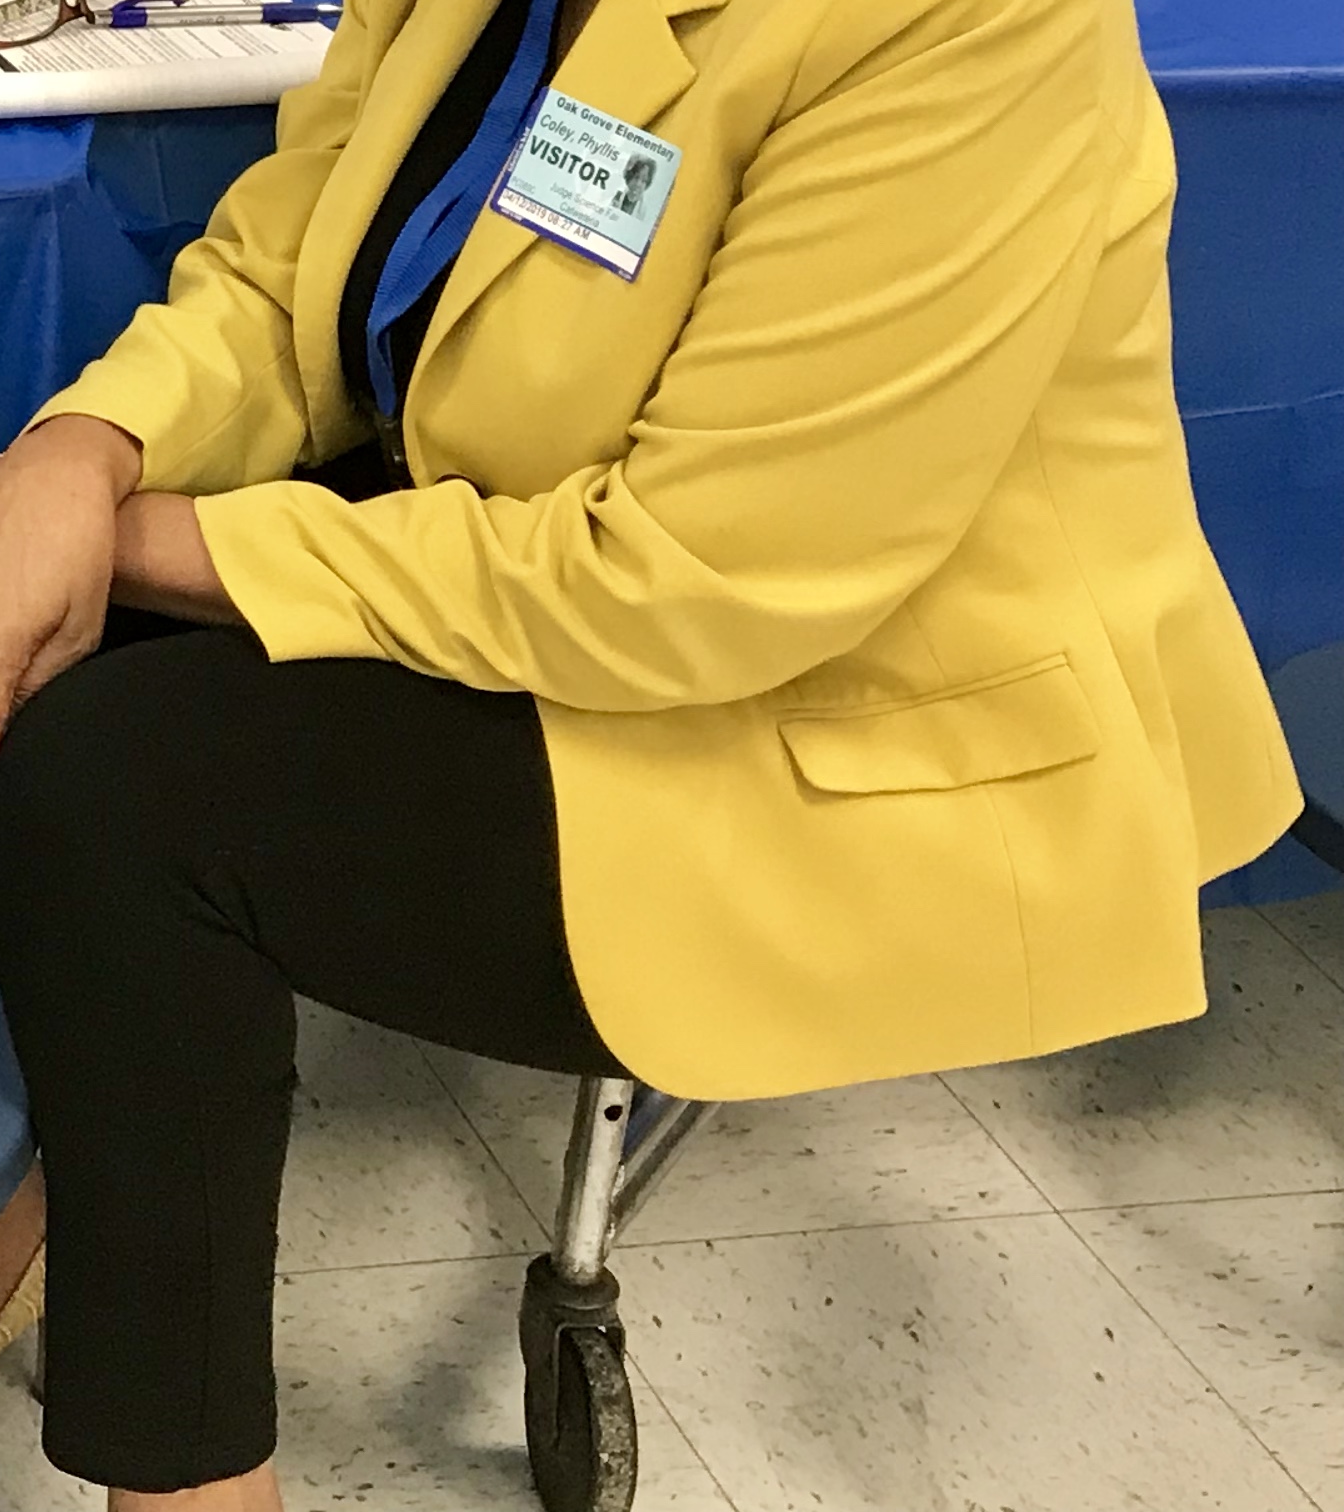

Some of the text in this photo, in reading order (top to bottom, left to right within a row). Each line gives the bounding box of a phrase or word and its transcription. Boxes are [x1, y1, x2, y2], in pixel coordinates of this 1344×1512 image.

[540, 114, 620, 161] Coley, Phyllis
[557, 97, 674, 162] Oak Grove Elementary
[530, 136, 610, 189] VISITOR
[573, 226, 591, 240] AM
